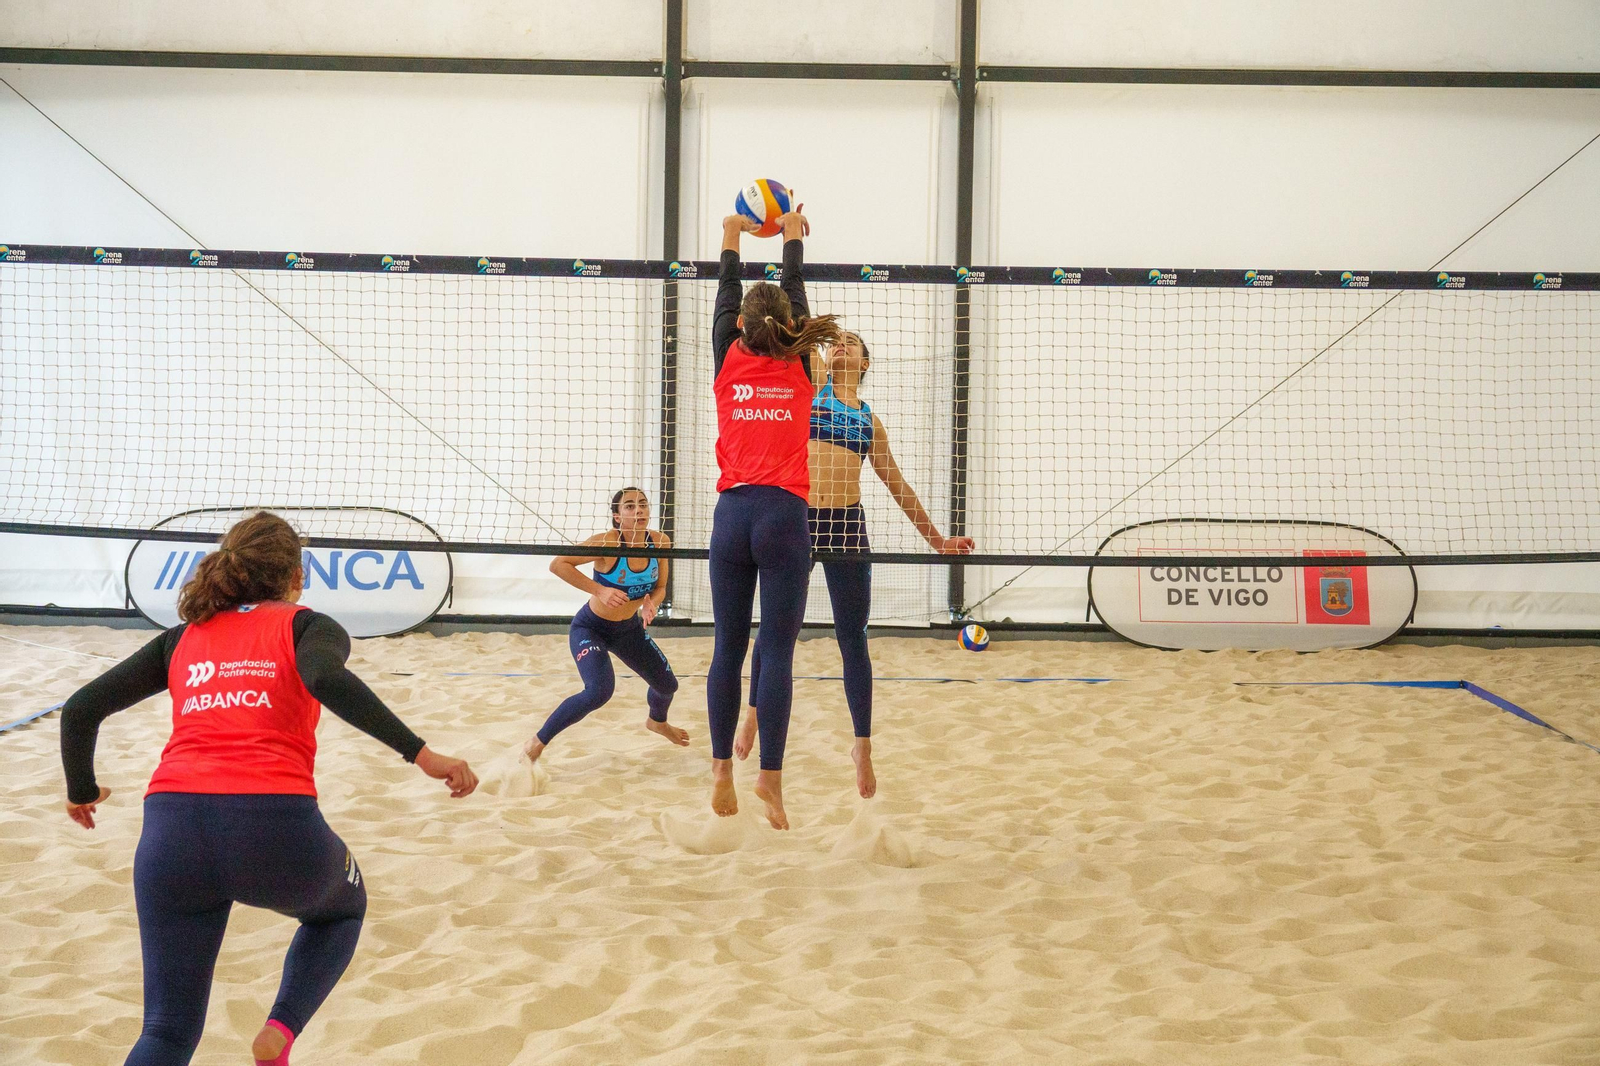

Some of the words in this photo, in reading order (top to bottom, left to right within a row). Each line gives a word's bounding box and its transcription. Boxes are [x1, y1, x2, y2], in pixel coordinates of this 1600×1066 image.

[617, 569, 626, 583] 2
[1150, 566, 1283, 583] CONCELLO
[1167, 588, 1199, 606] DE
[1208, 588, 1268, 606] VIGO
[220, 660, 276, 670] Deputación
[218, 669, 275, 678] Pontevedra
